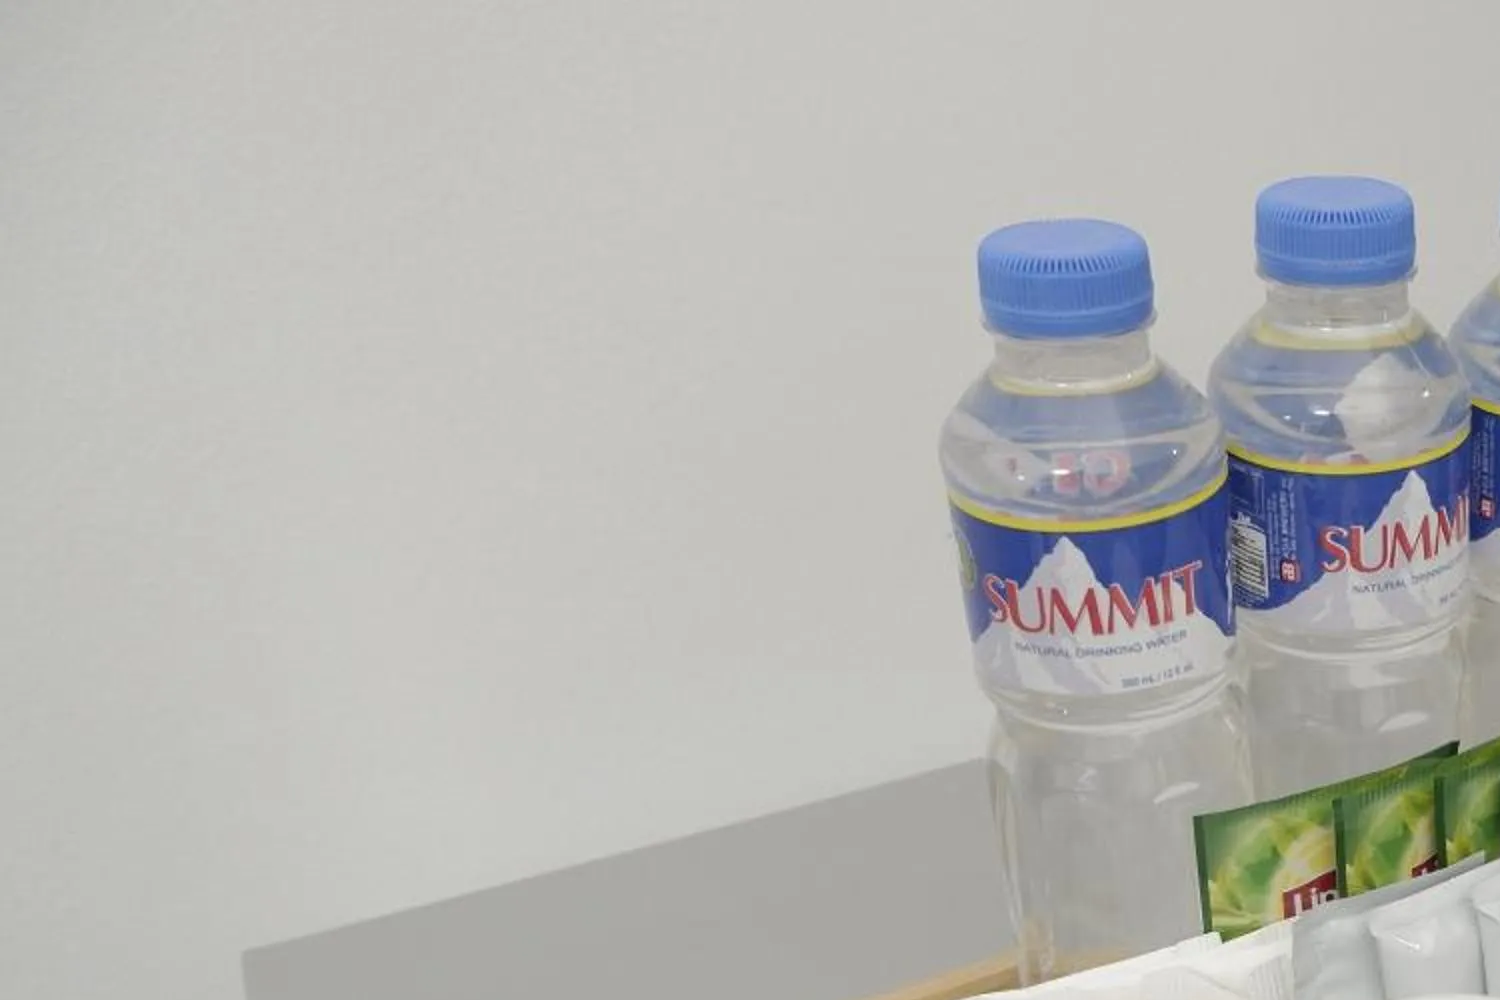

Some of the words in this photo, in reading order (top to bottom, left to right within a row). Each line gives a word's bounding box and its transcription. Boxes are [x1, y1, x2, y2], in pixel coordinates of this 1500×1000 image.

[982, 559, 1203, 636] SUMMIT
[1015, 641, 1072, 659] NATURAL
[1075, 643, 1143, 659] DRINKING
[1145, 629, 1188, 651] WATER
